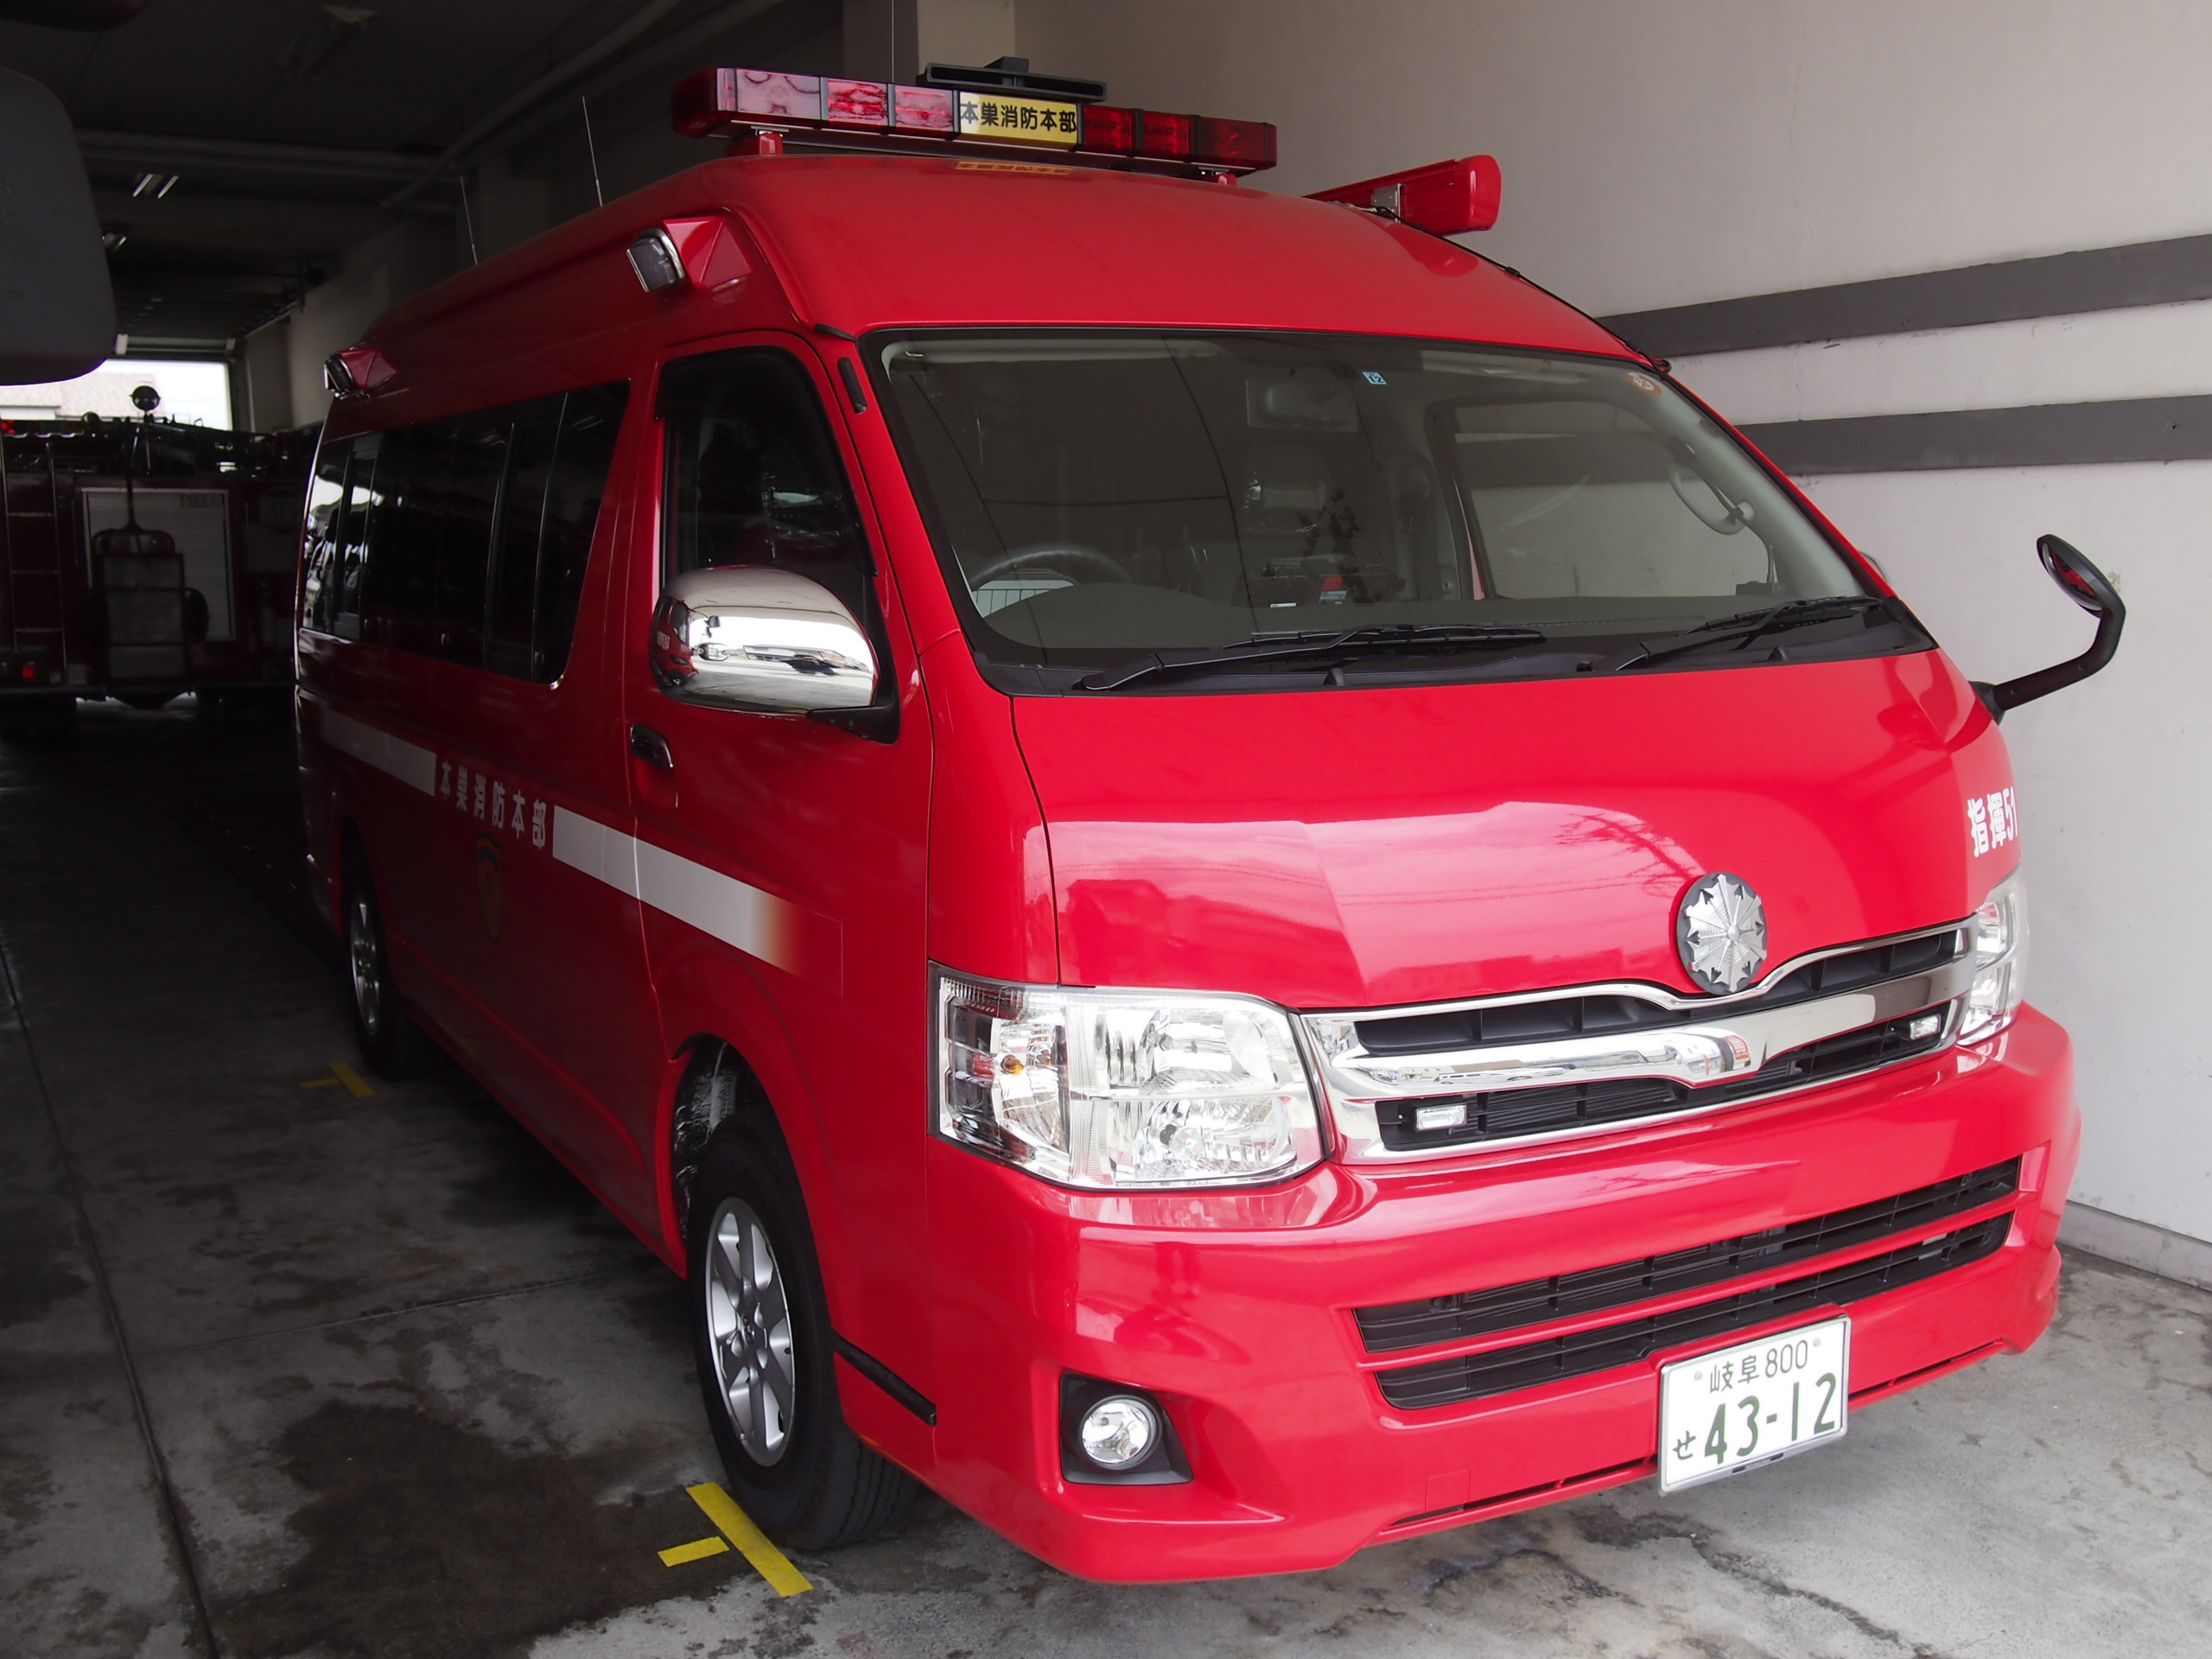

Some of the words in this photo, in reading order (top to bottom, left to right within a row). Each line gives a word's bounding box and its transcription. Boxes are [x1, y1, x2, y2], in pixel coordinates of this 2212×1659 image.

[960, 101, 1077, 133] 本巣消防本部
[441, 759, 546, 849] 本巣消防本部
[1672, 1430, 1697, 1460] せ
[1704, 1372, 1837, 1465] 43-12
